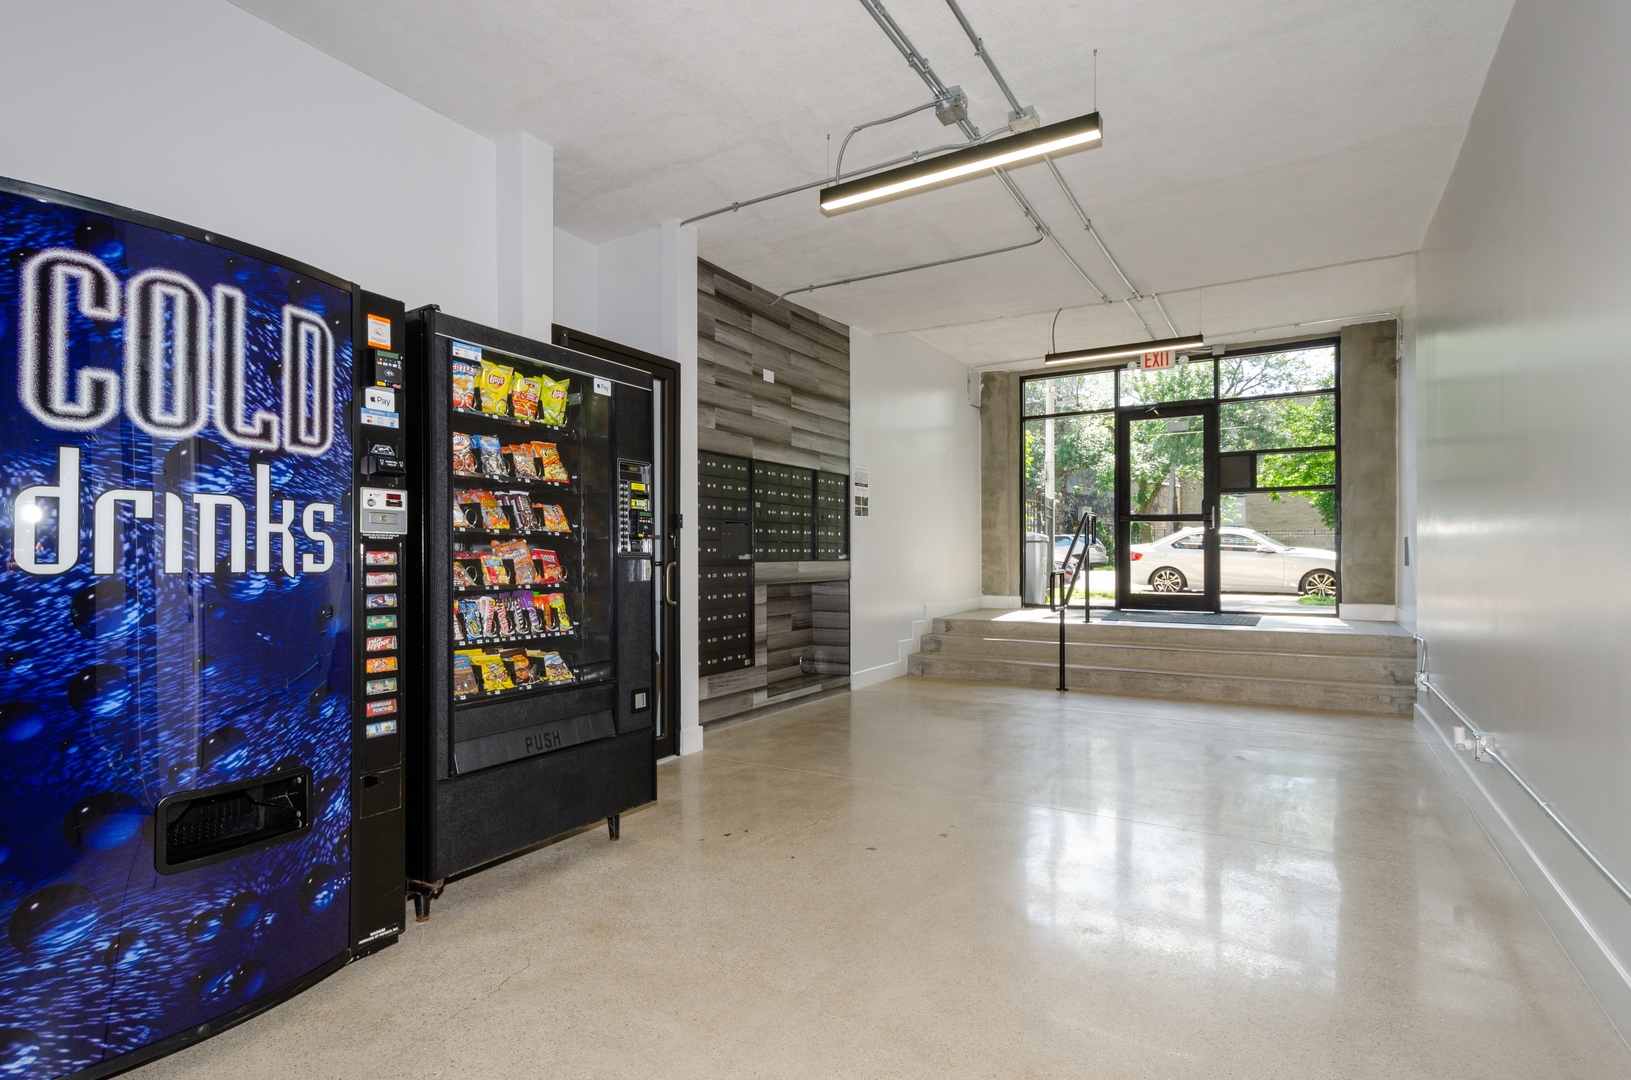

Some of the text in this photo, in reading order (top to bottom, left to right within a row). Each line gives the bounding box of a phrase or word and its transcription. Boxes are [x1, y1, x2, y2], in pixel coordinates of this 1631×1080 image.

[19, 246, 336, 457] COLD
[1144, 351, 1170, 368] EXIT
[489, 374, 505, 386] Lay's
[601, 384, 610, 392] Pay
[377, 396, 391, 406] Pay
[14, 446, 335, 578] drinks
[369, 617, 390, 626] Sprite
[525, 730, 561, 753] PUSH
